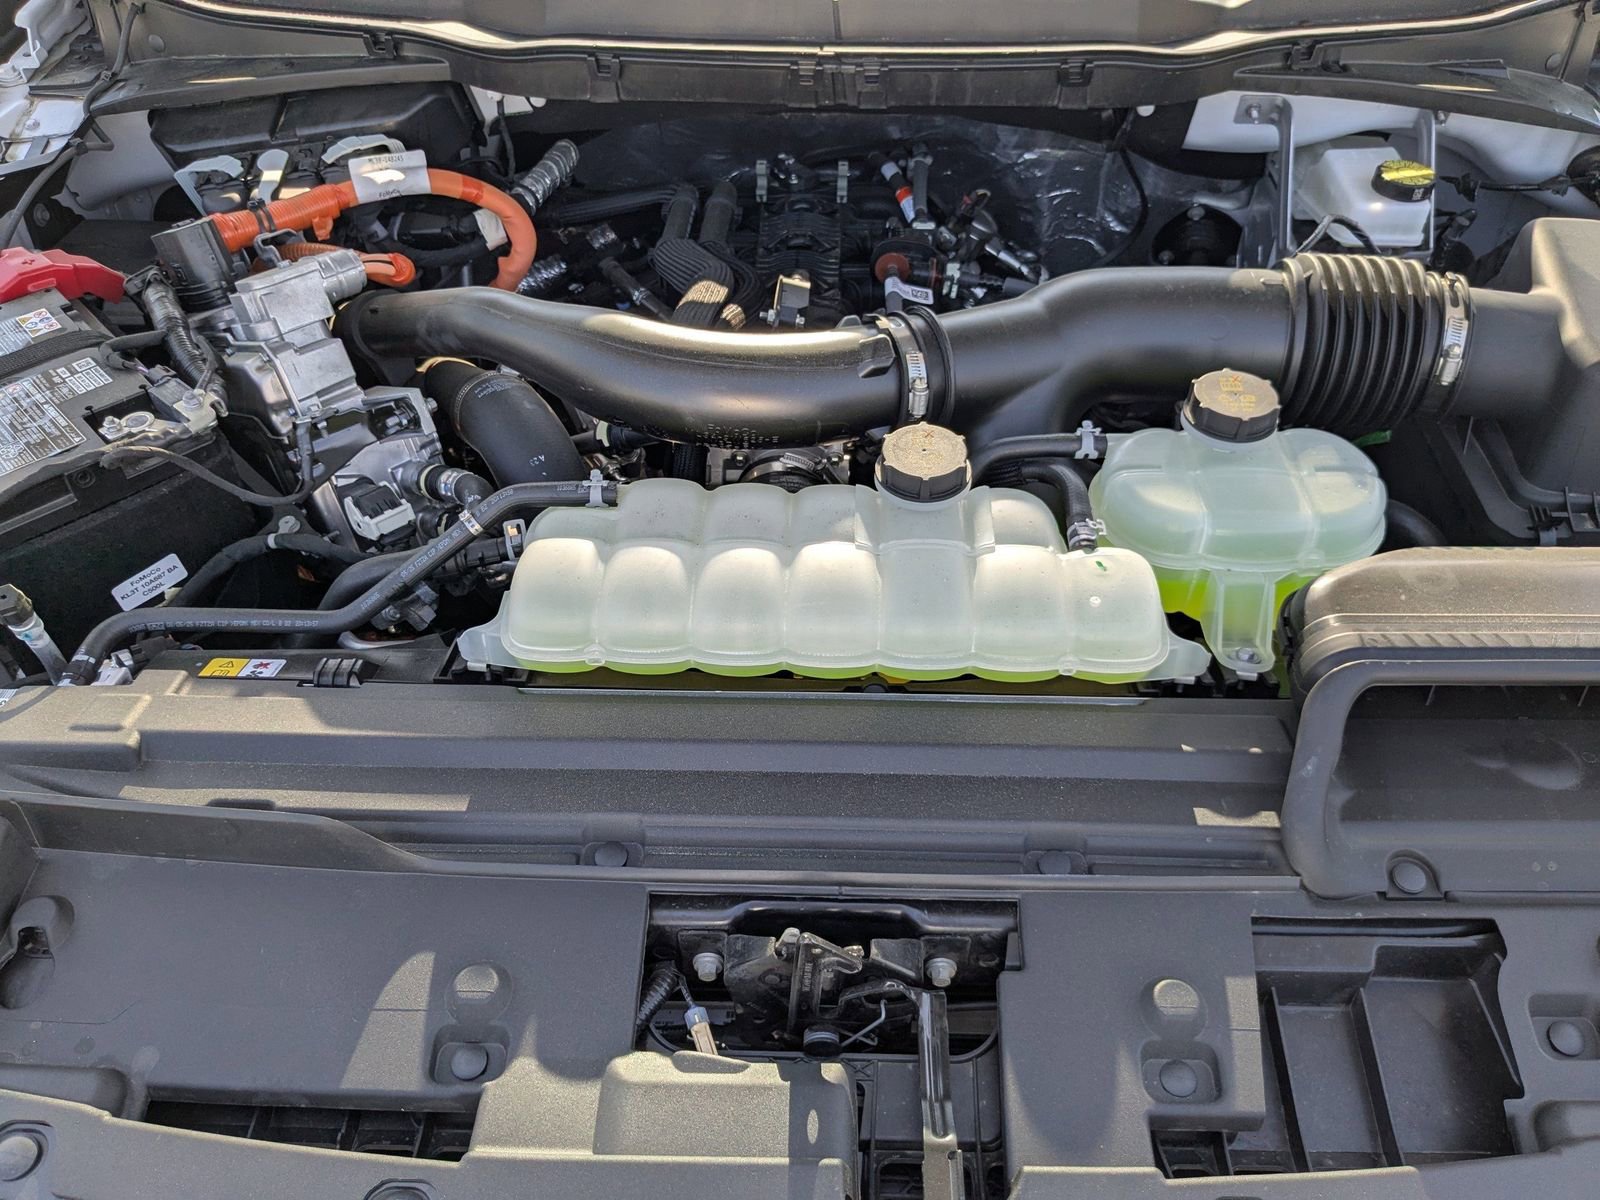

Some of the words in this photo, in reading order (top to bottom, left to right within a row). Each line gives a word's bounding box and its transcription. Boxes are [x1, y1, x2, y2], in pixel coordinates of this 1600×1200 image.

[129, 567, 161, 586] FoMoCo
[120, 587, 140, 601] KL3T
[142, 582, 165, 596] C500L
